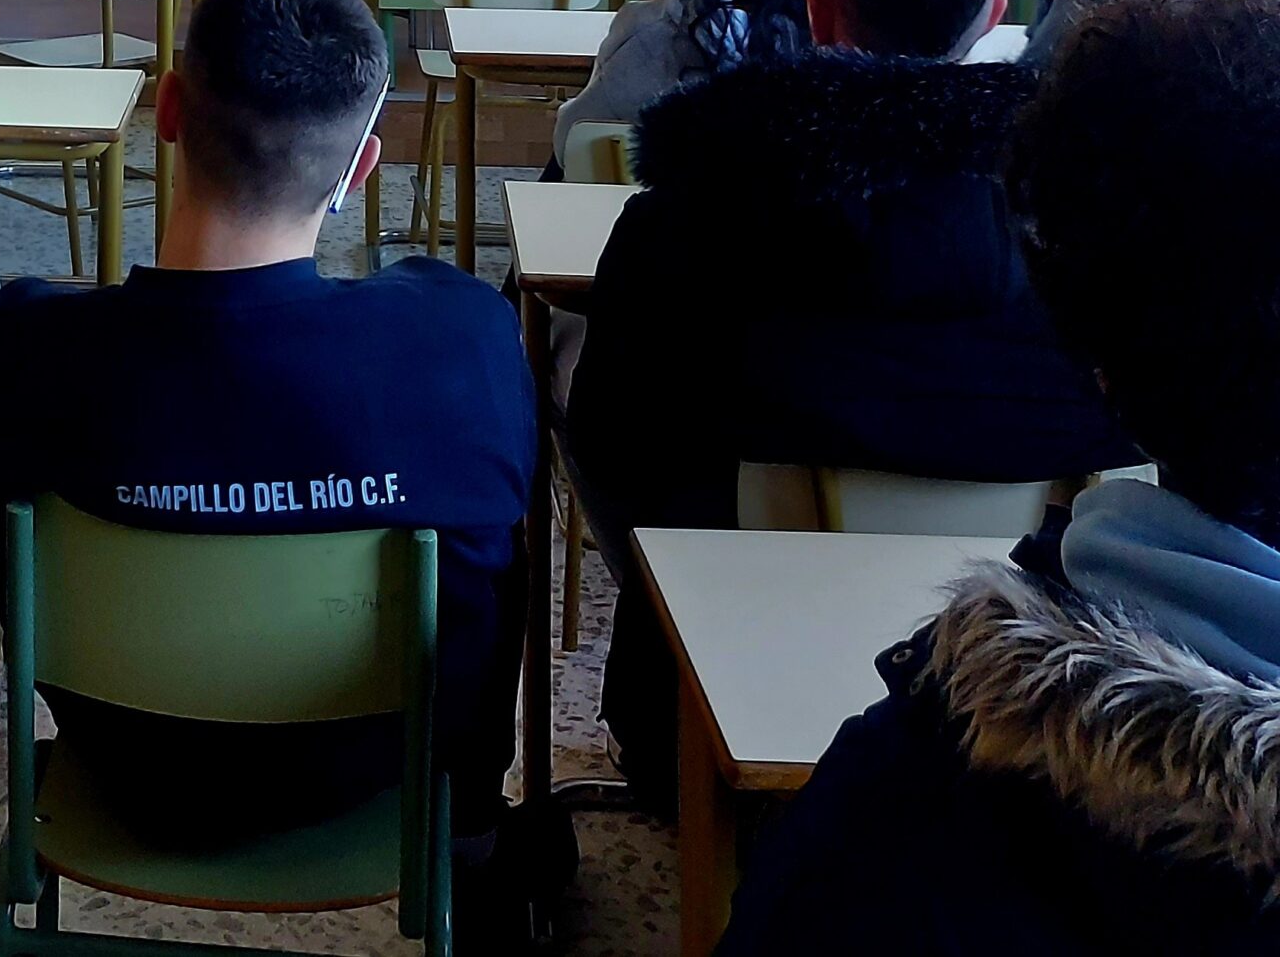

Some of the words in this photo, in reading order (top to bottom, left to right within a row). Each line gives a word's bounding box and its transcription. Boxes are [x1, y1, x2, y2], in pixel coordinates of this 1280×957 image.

[116, 484, 245, 512] CAMPILLO
[254, 482, 303, 512] DEL
[310, 473, 354, 510] RÍO
[361, 472, 406, 506] C.F.
